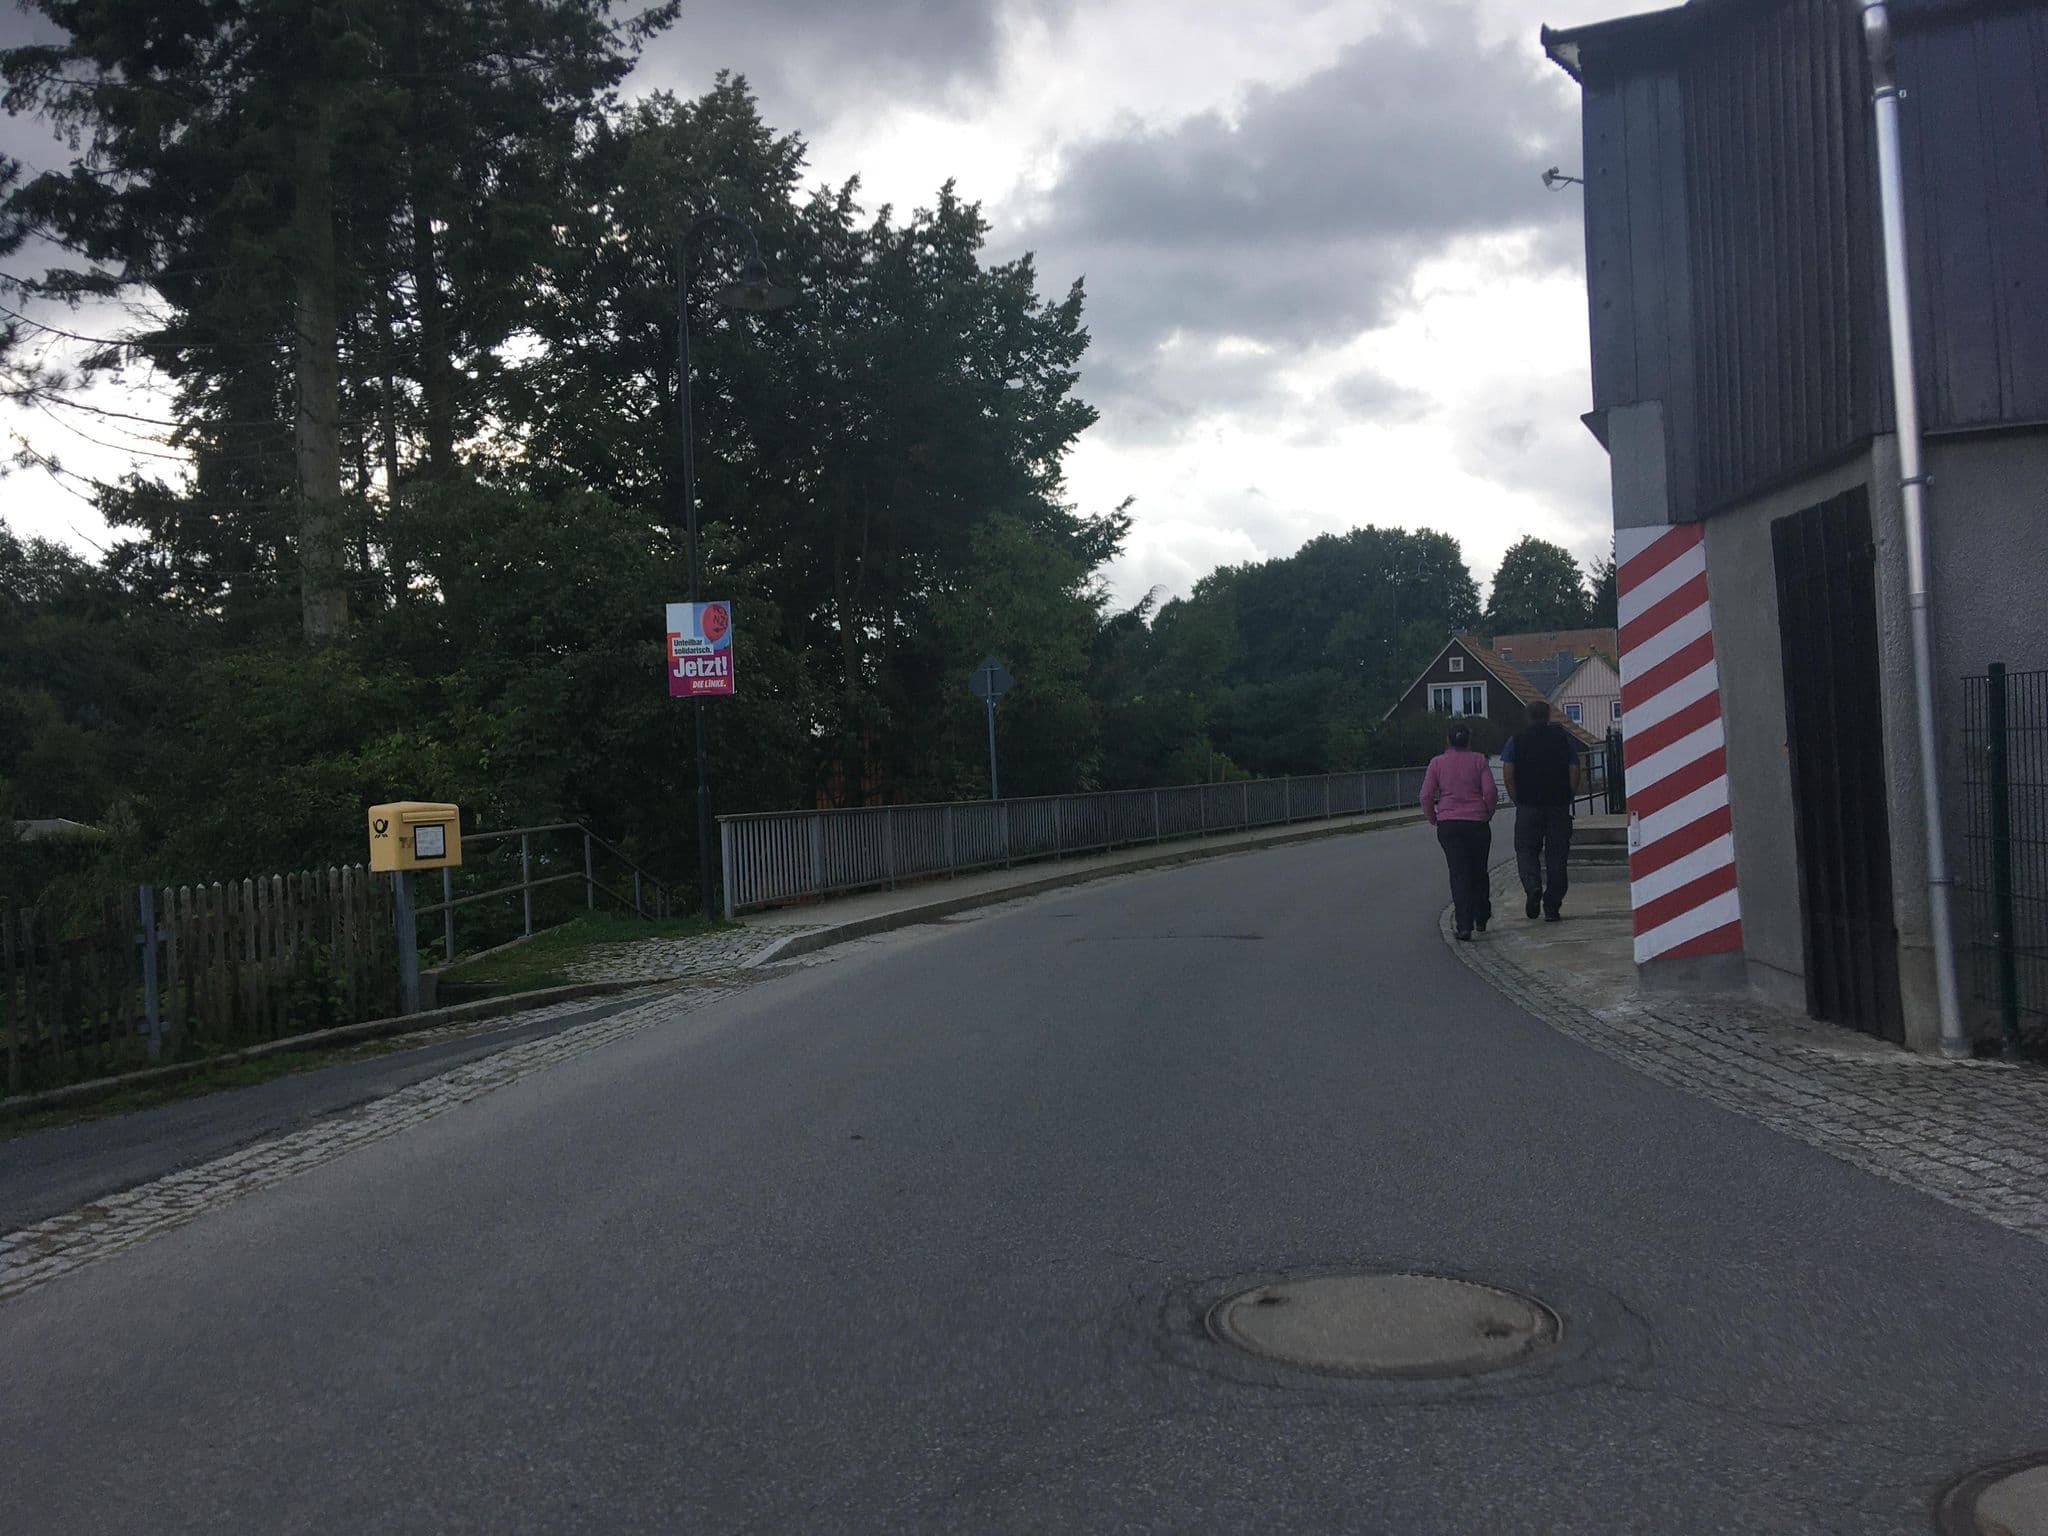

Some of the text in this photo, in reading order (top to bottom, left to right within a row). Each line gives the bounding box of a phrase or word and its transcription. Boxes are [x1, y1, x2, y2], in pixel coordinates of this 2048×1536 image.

[673, 639, 703, 647] Unteilbar
[674, 646, 712, 655] solidarisch.
[673, 656, 728, 677] Jetzt!
[692, 680, 704, 688] DIE
